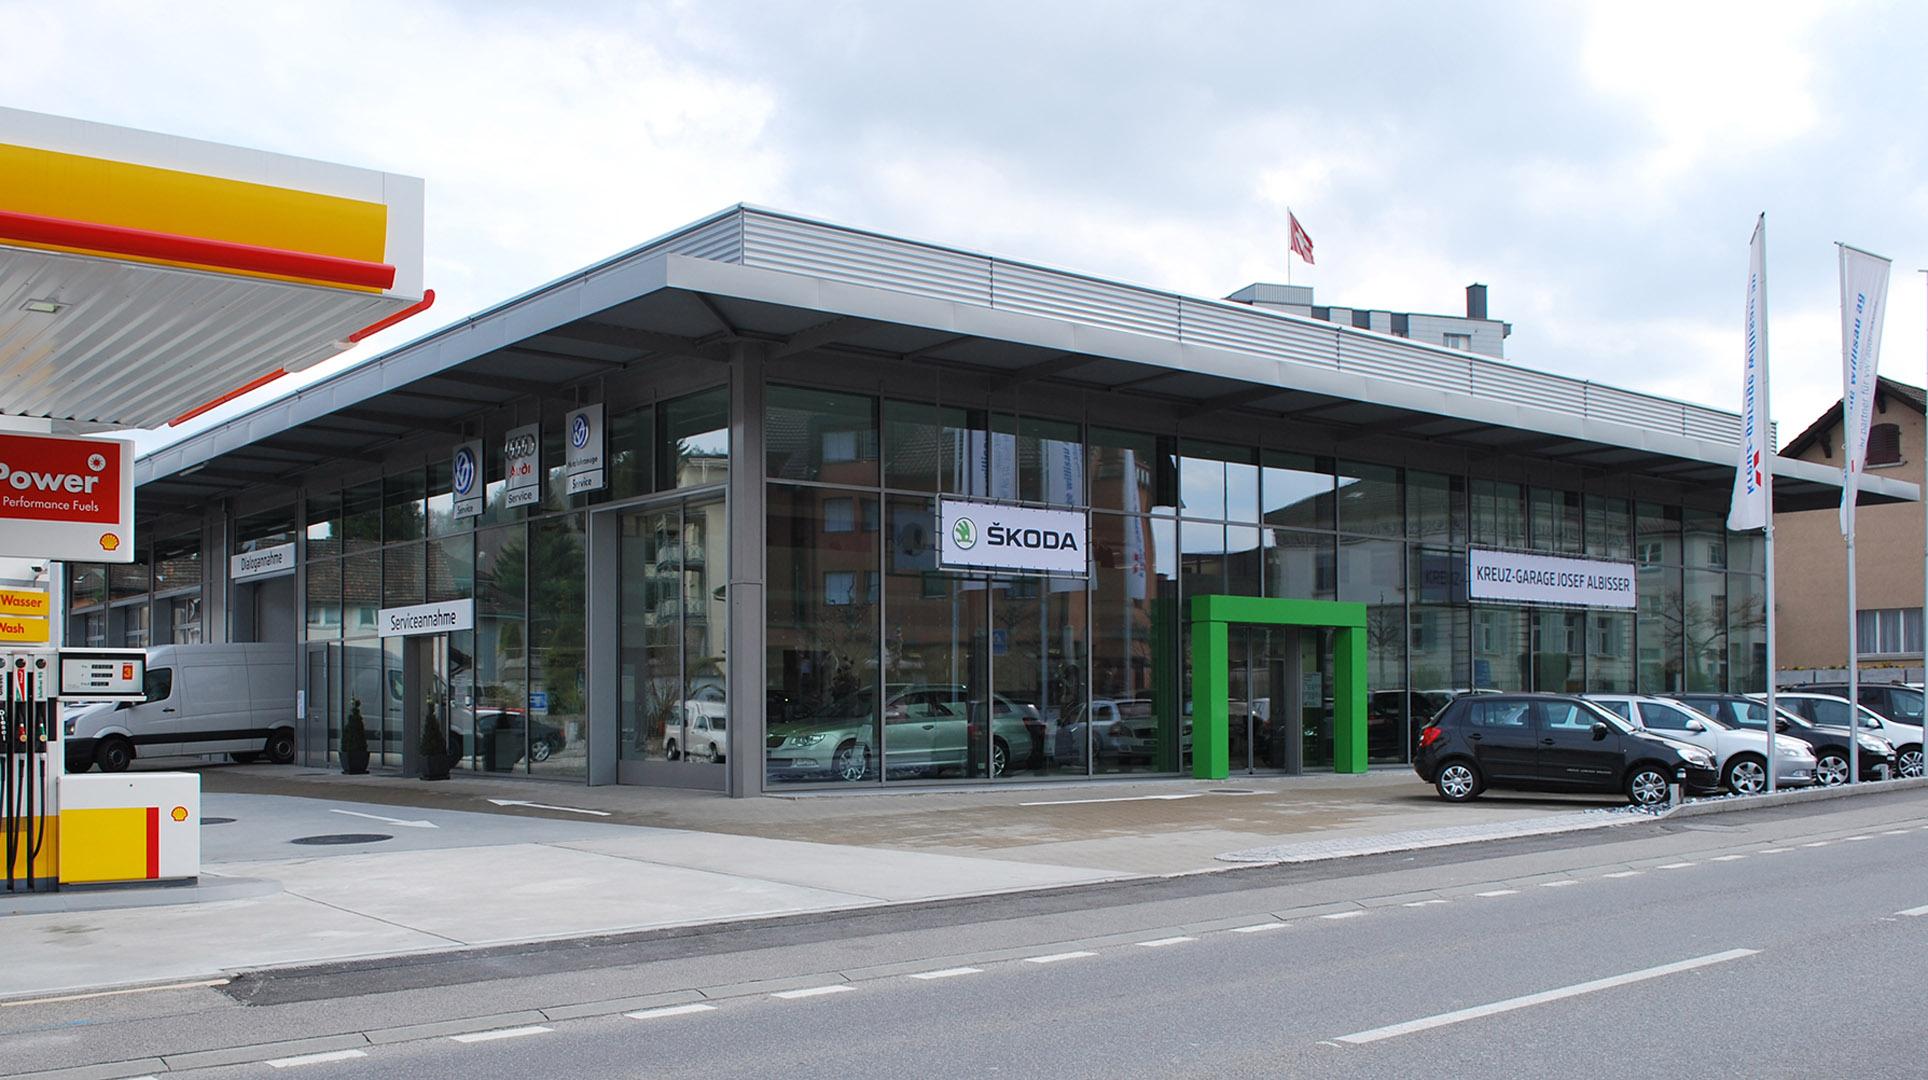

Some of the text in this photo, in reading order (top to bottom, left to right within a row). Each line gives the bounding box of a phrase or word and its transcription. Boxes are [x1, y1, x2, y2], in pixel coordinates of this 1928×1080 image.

[1850, 318, 1861, 385] willisau
[1857, 292, 1865, 314] ag
[3, 496, 99, 512] Performance Fuels
[508, 491, 532, 504] Service
[457, 504, 473, 513] Service
[987, 522, 1078, 551] ŠKODA
[240, 552, 283, 573] Dialogannahme
[1476, 565, 1630, 592] KREUZ-GARAGE JOSEF ALBISSER
[0, 594, 42, 608] Wasser
[390, 608, 457, 631] Serviceannahme
[123, 666, 132, 679] 3
